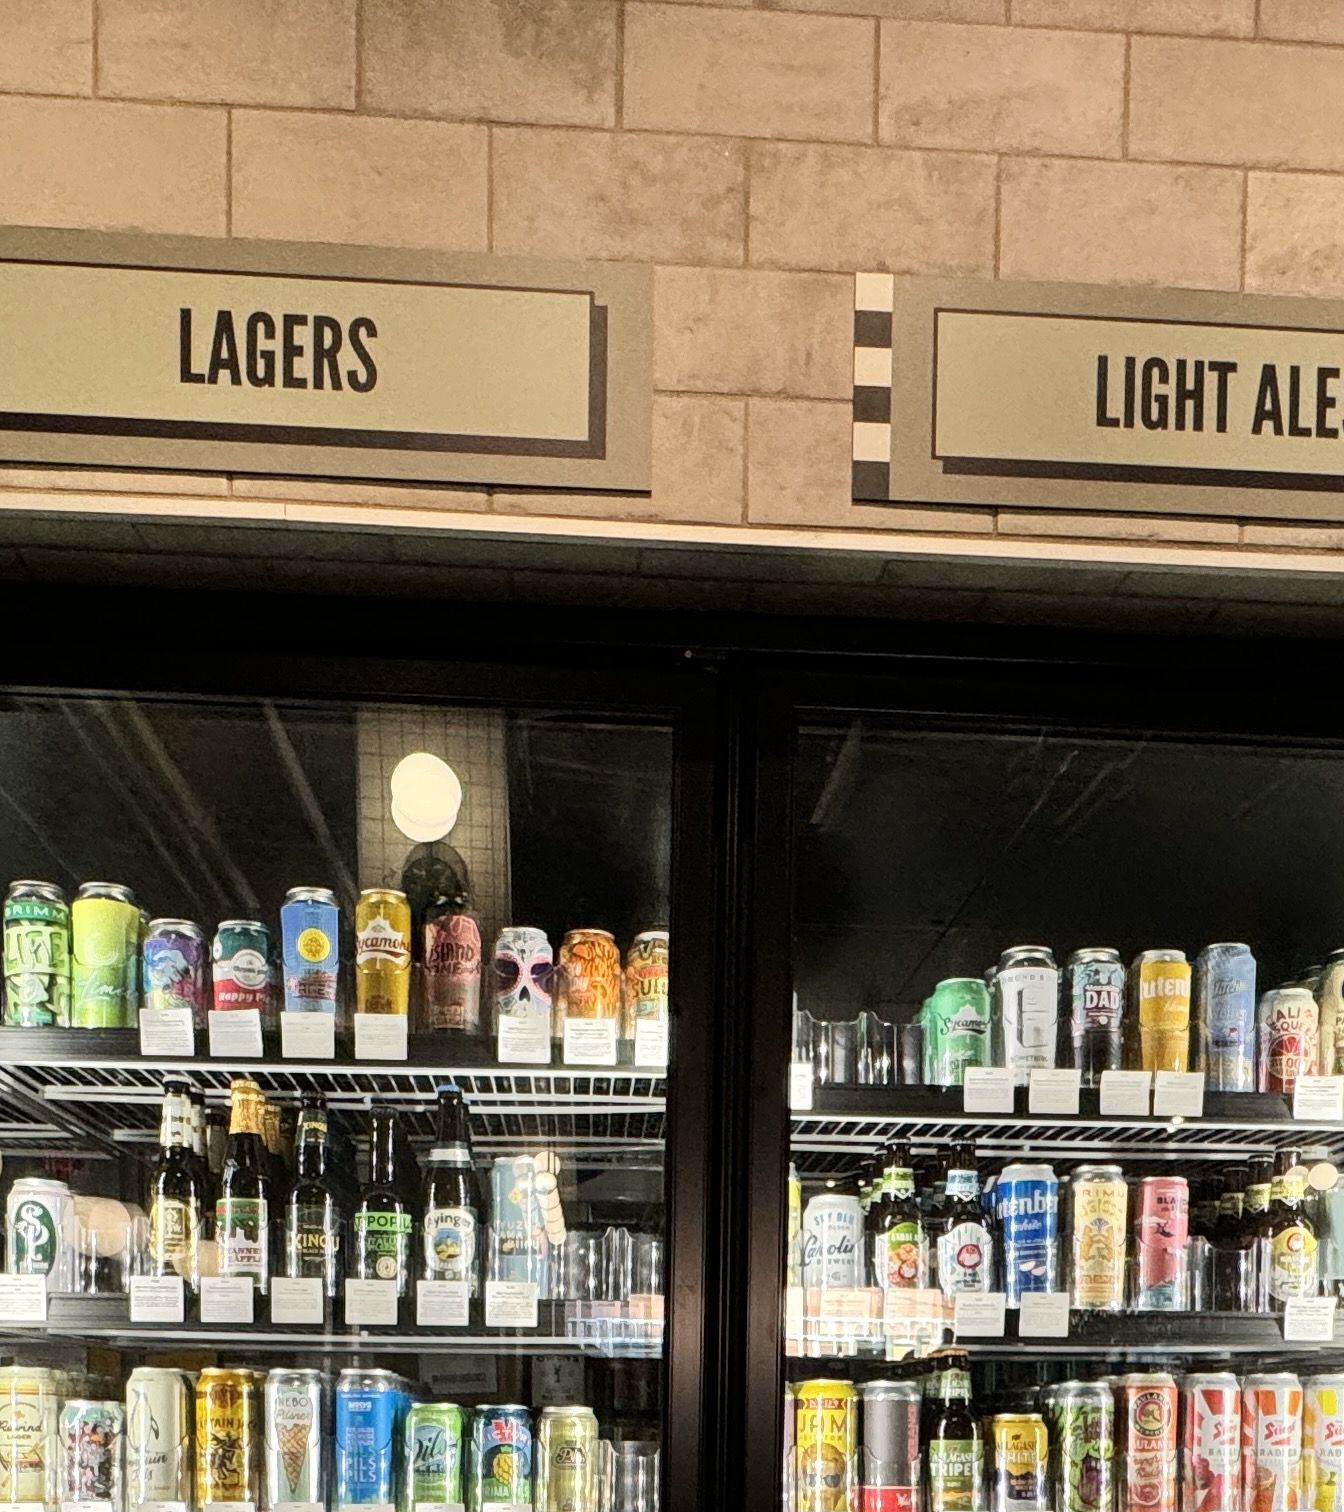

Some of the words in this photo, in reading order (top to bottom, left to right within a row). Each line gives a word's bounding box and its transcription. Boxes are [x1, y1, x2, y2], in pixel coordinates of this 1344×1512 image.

[179, 308, 379, 393] LAGERS
[1095, 354, 1237, 434] LIGHT
[1084, 990, 1120, 1010] DAD
